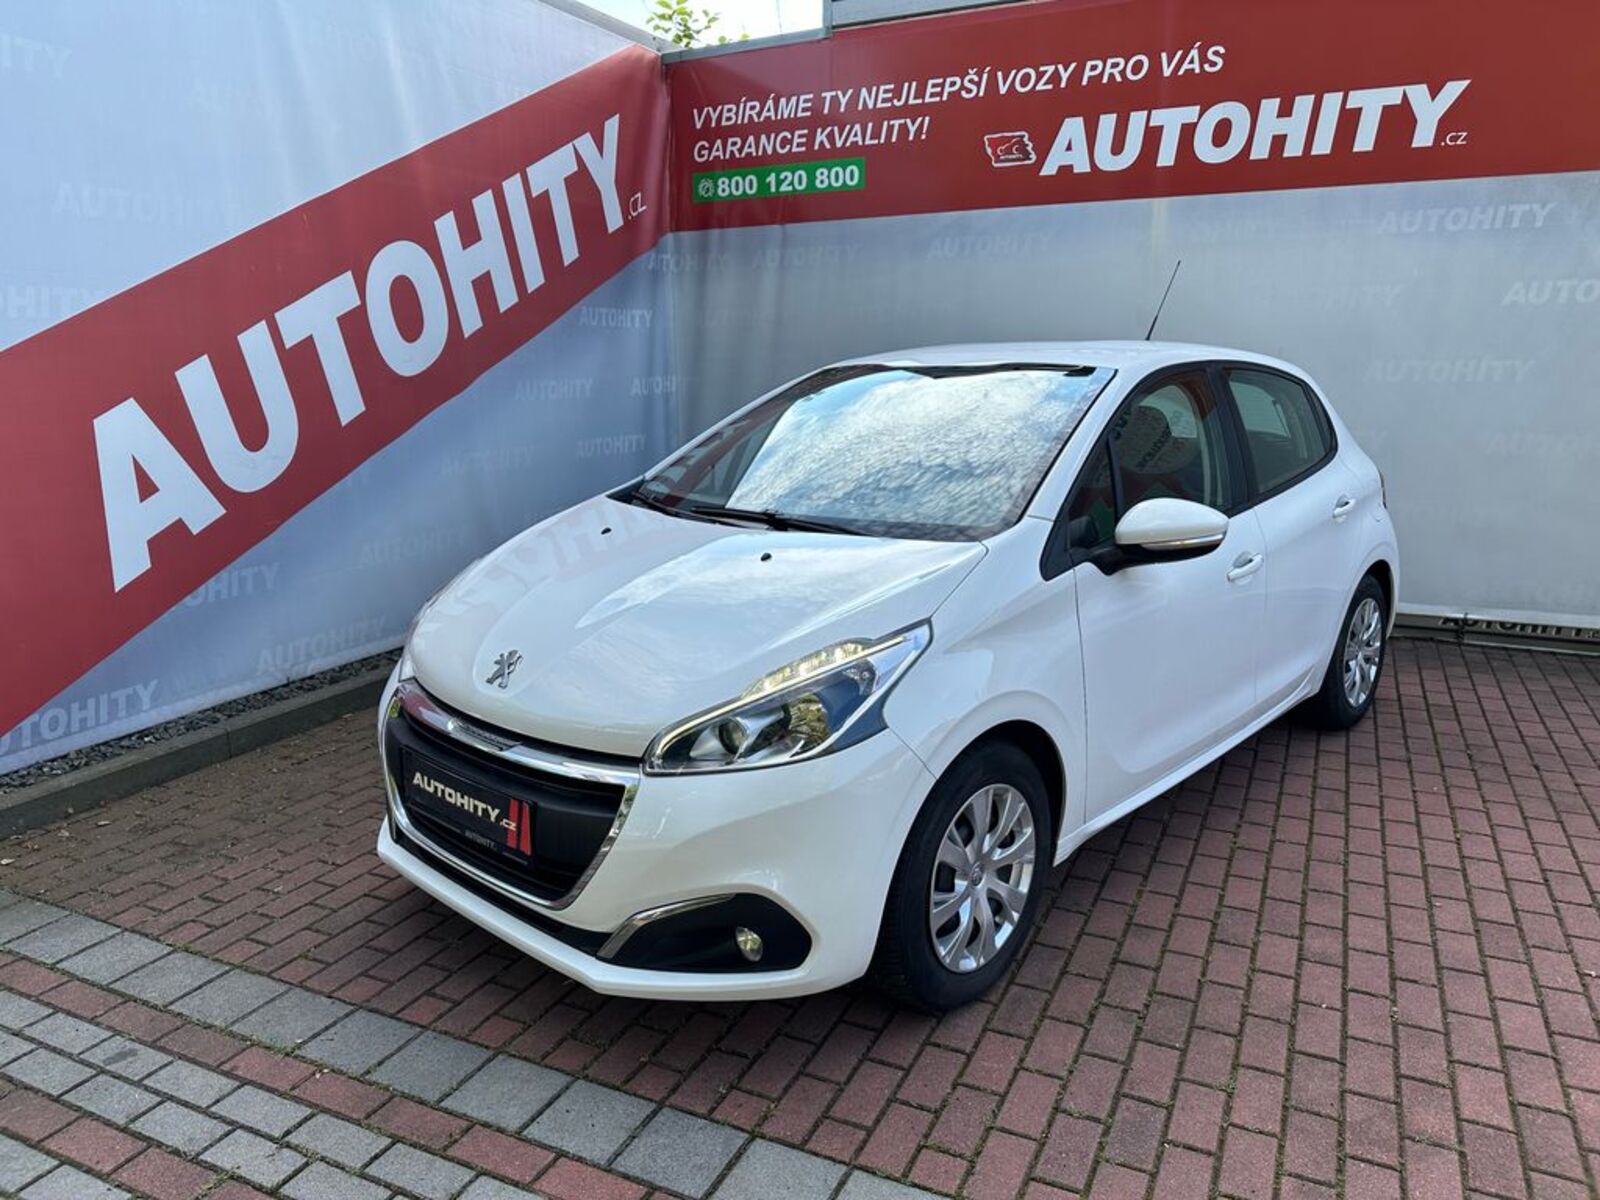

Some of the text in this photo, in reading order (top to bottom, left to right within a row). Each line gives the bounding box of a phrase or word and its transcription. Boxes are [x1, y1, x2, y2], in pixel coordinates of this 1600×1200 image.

[693, 42, 1225, 129] VYBÍRÁME TY NEJLEPŠÍ VOZY PRO VÁS
[693, 116, 930, 162] GARANCE KVALITY!
[717, 165, 859, 197] 800 120 800
[1376, 202, 1557, 235] AUTOHITY
[578, 306, 653, 329] AUTOHITY
[1363, 357, 1536, 385] AUTOHITY
[514, 376, 593, 402] AUTOHITY
[576, 433, 646, 461] AUTOHITY
